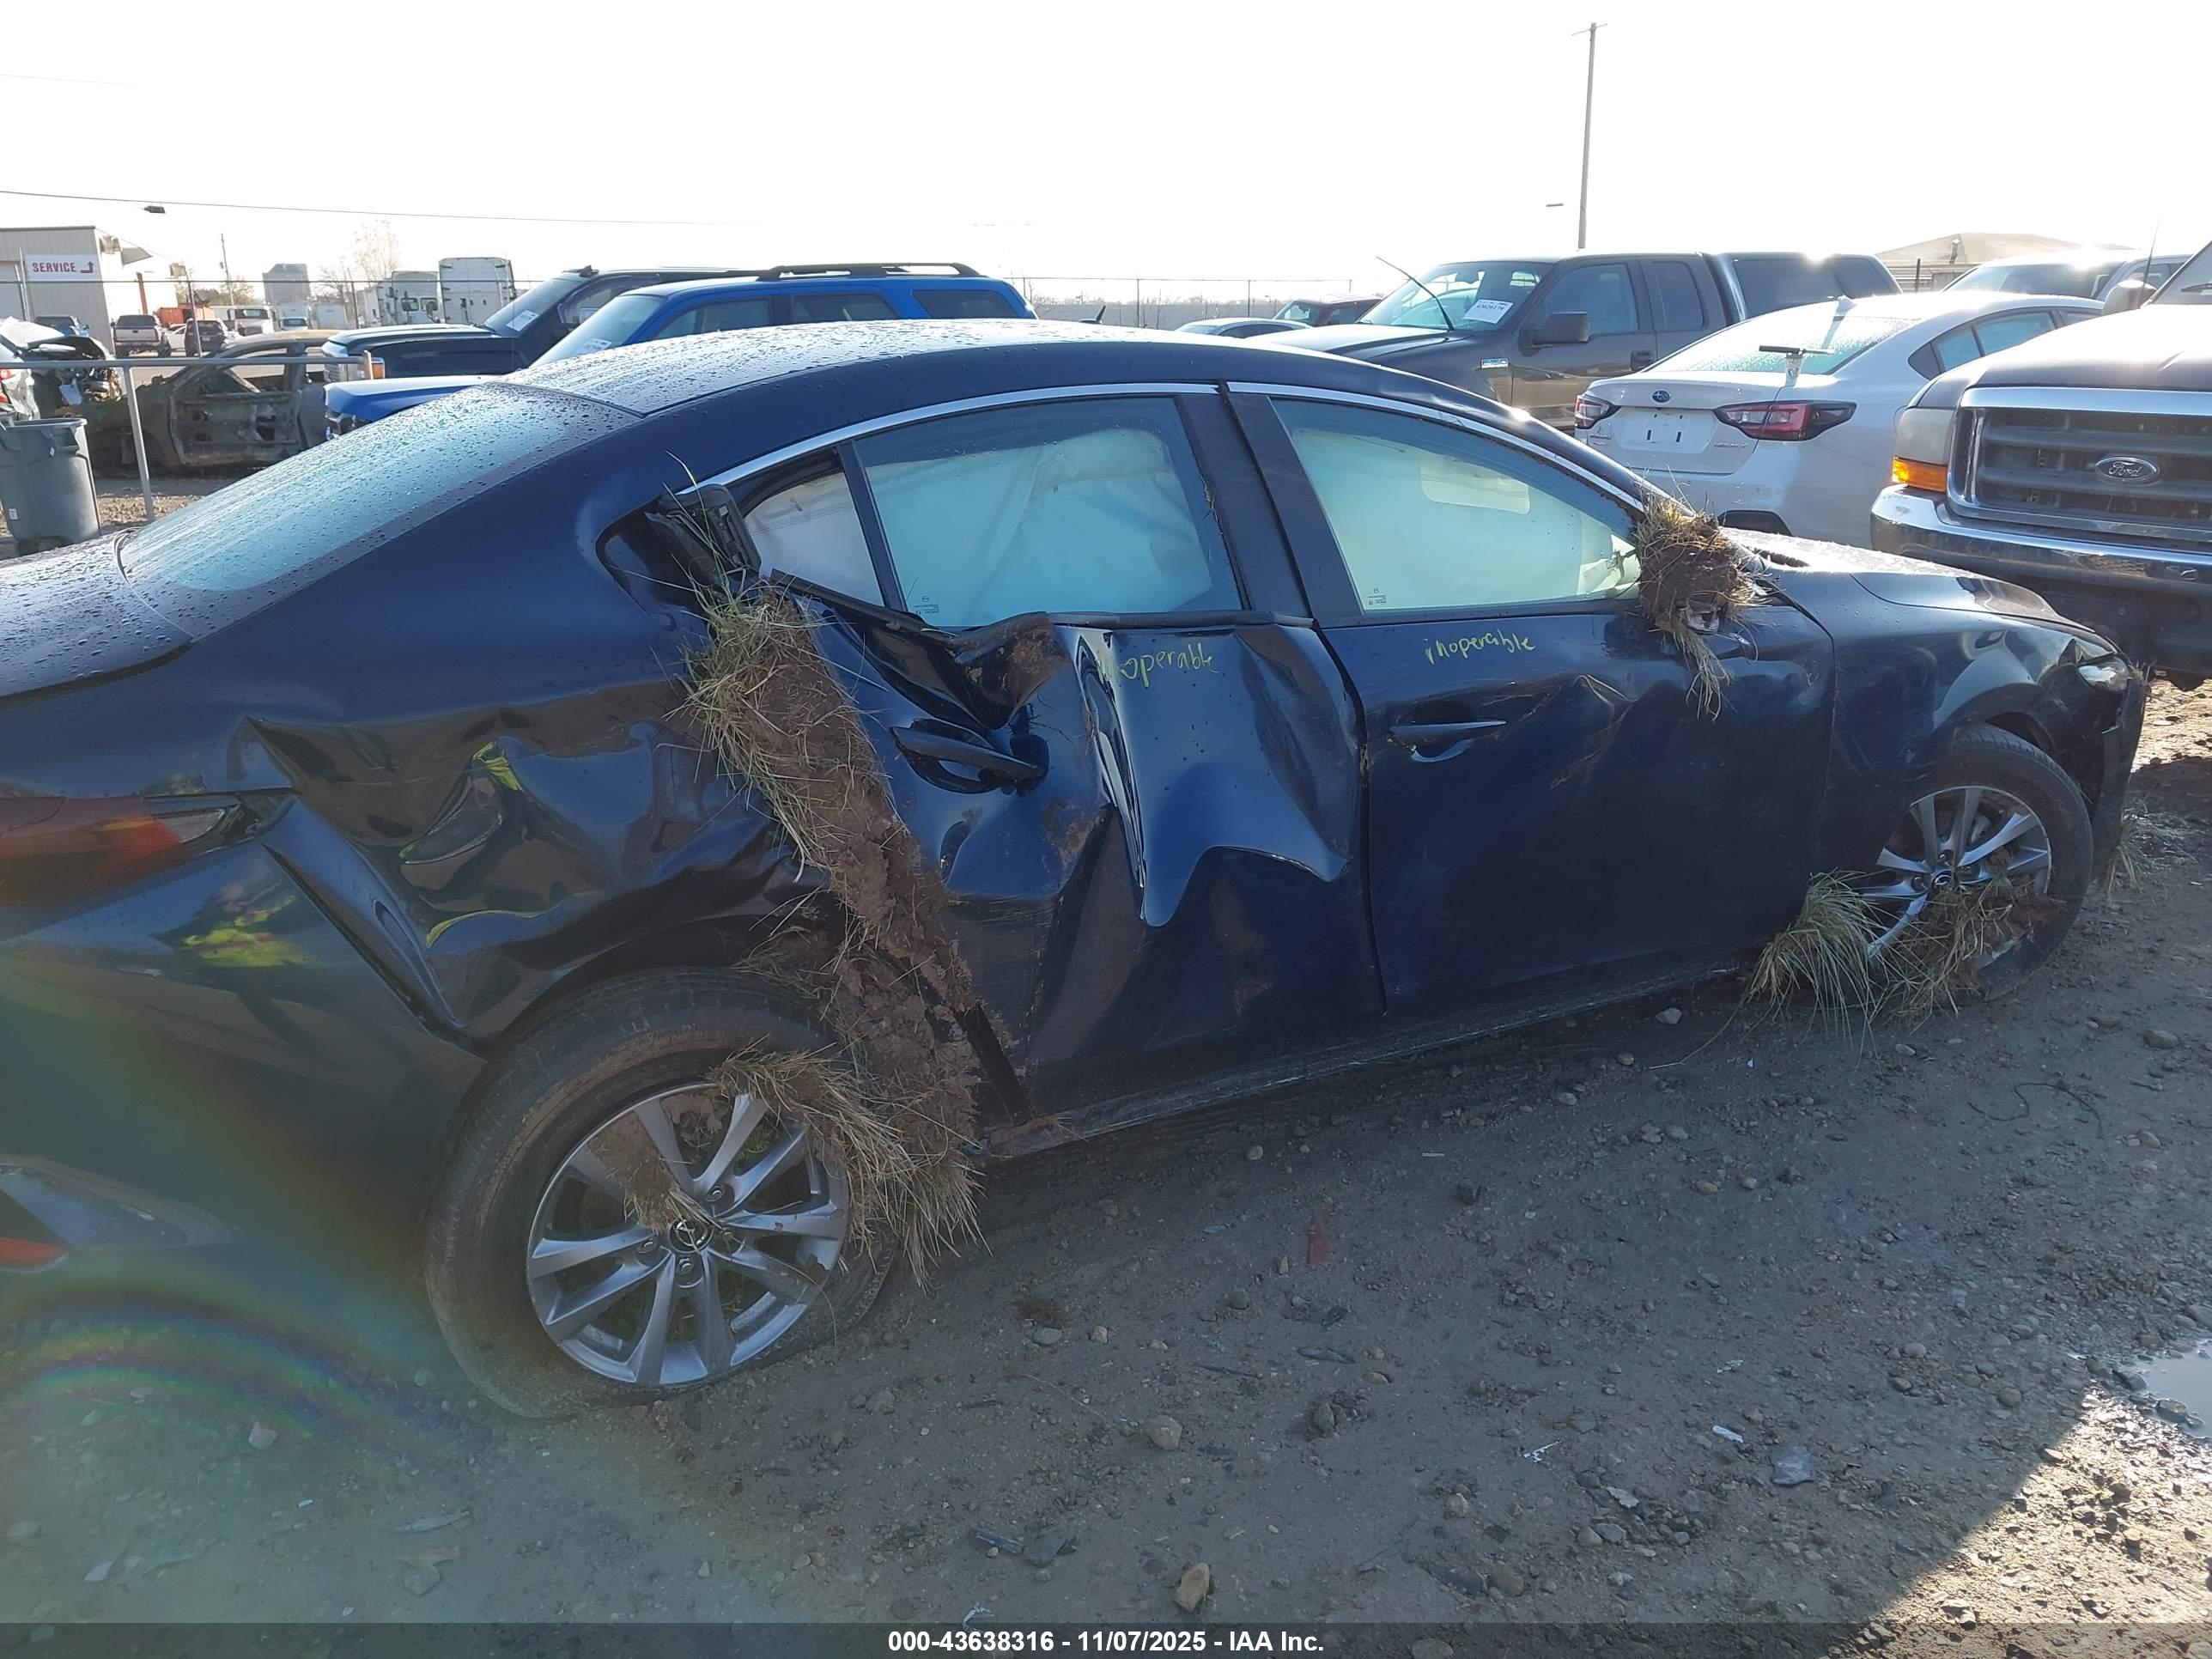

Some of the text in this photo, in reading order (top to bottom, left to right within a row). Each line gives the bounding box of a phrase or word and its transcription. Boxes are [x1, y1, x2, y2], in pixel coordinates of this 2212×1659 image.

[32, 262, 76, 273] SERVICE
[2108, 460, 2144, 477] Ford
[1423, 629, 1537, 665] inoperable
